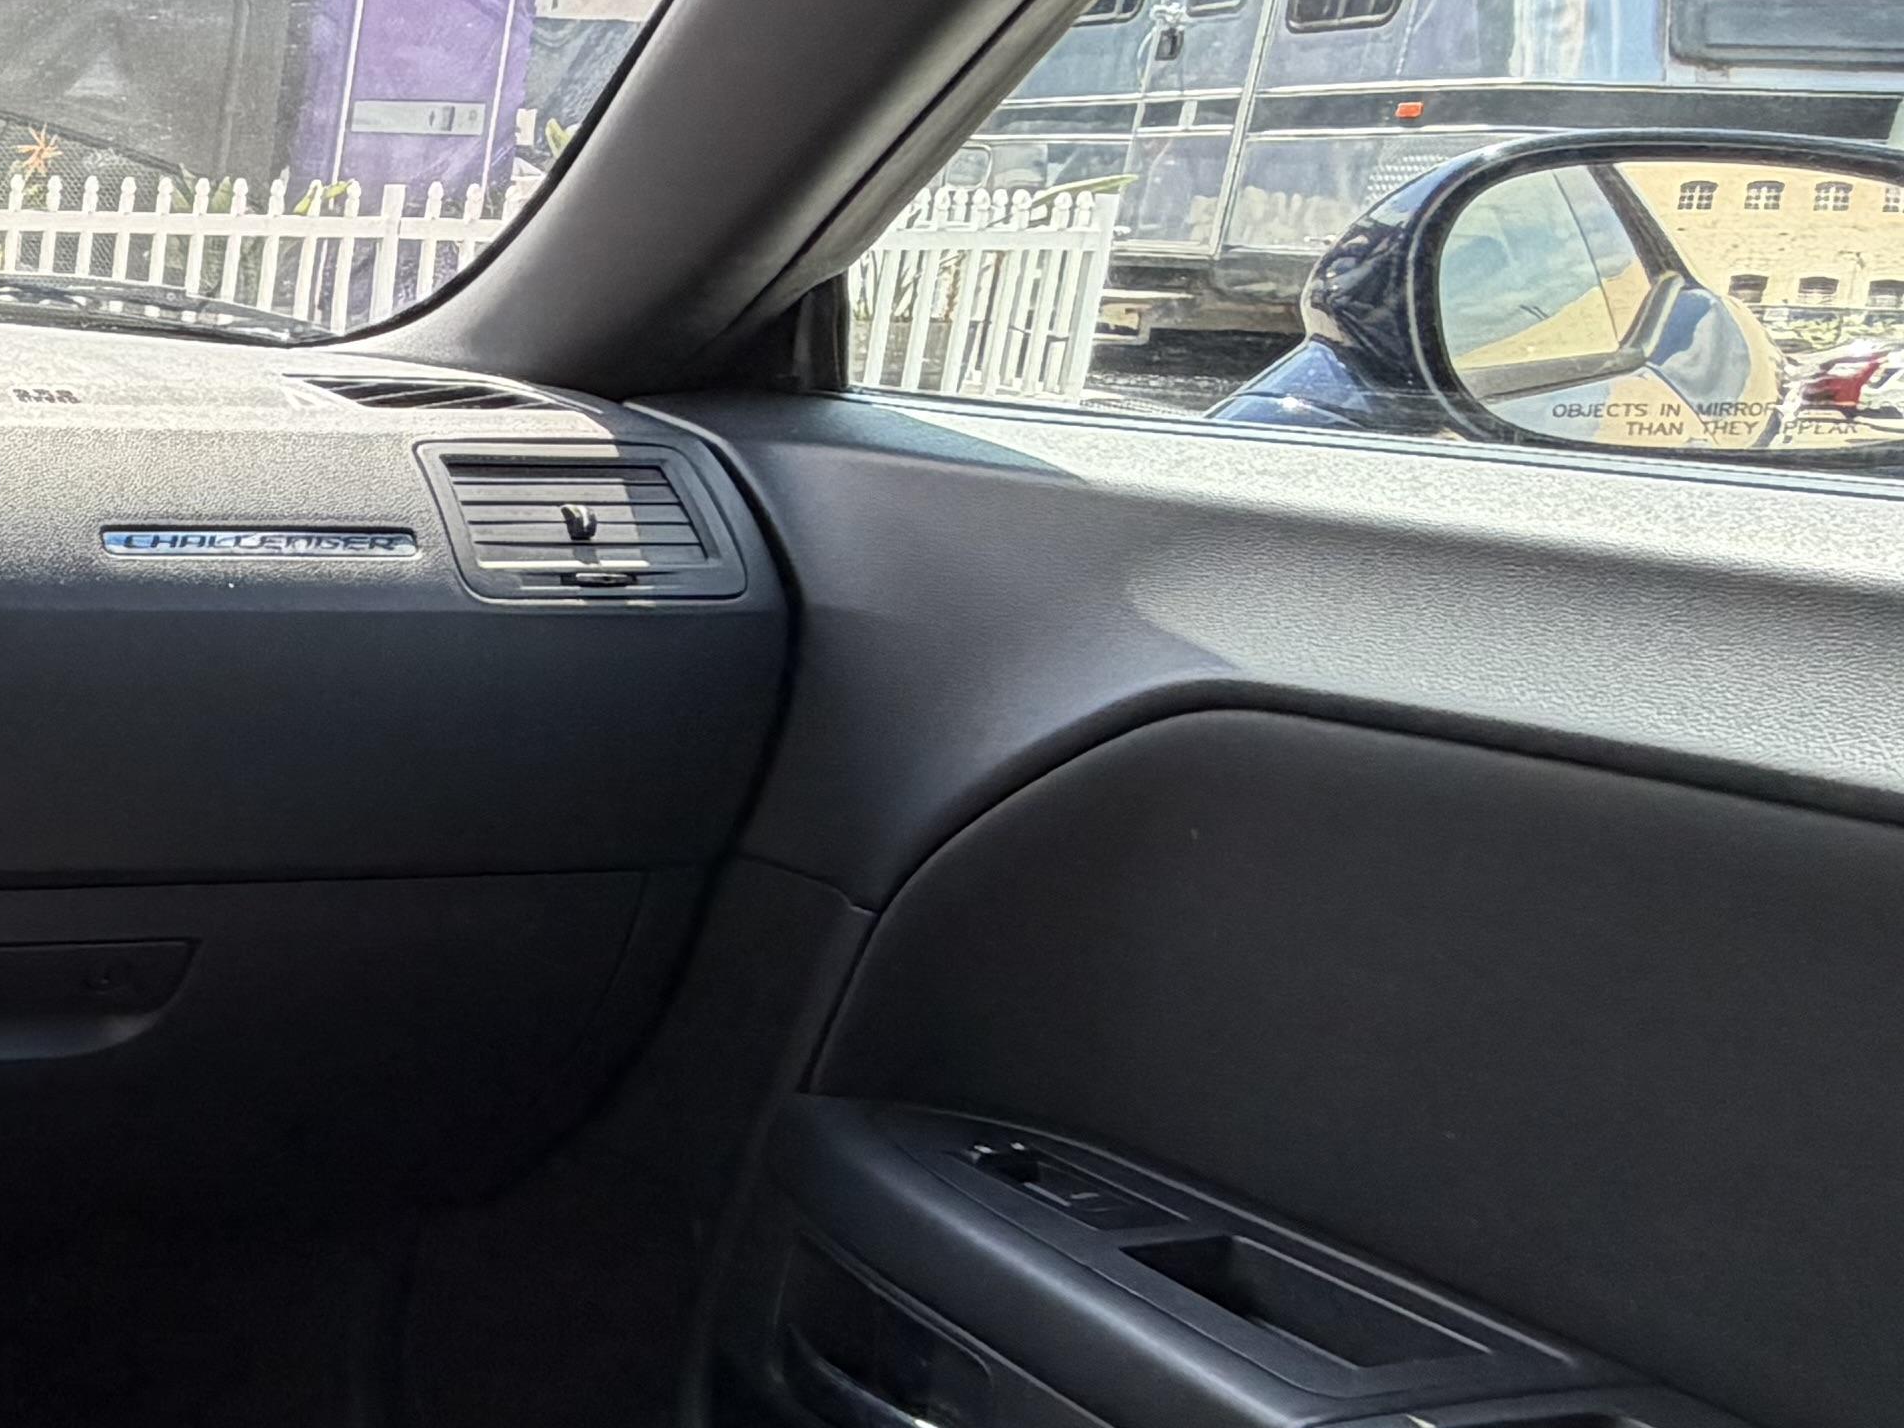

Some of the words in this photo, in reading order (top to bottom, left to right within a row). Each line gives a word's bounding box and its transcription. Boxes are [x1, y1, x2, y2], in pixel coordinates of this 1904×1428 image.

[1552, 403, 1649, 418] OBJECTS
[1659, 403, 1680, 417] IN
[1626, 421, 1684, 435] THAN
[1702, 421, 1760, 435] THEY
[1781, 421, 1858, 435] PPEAR
[124, 534, 396, 551] CHALLENGER
